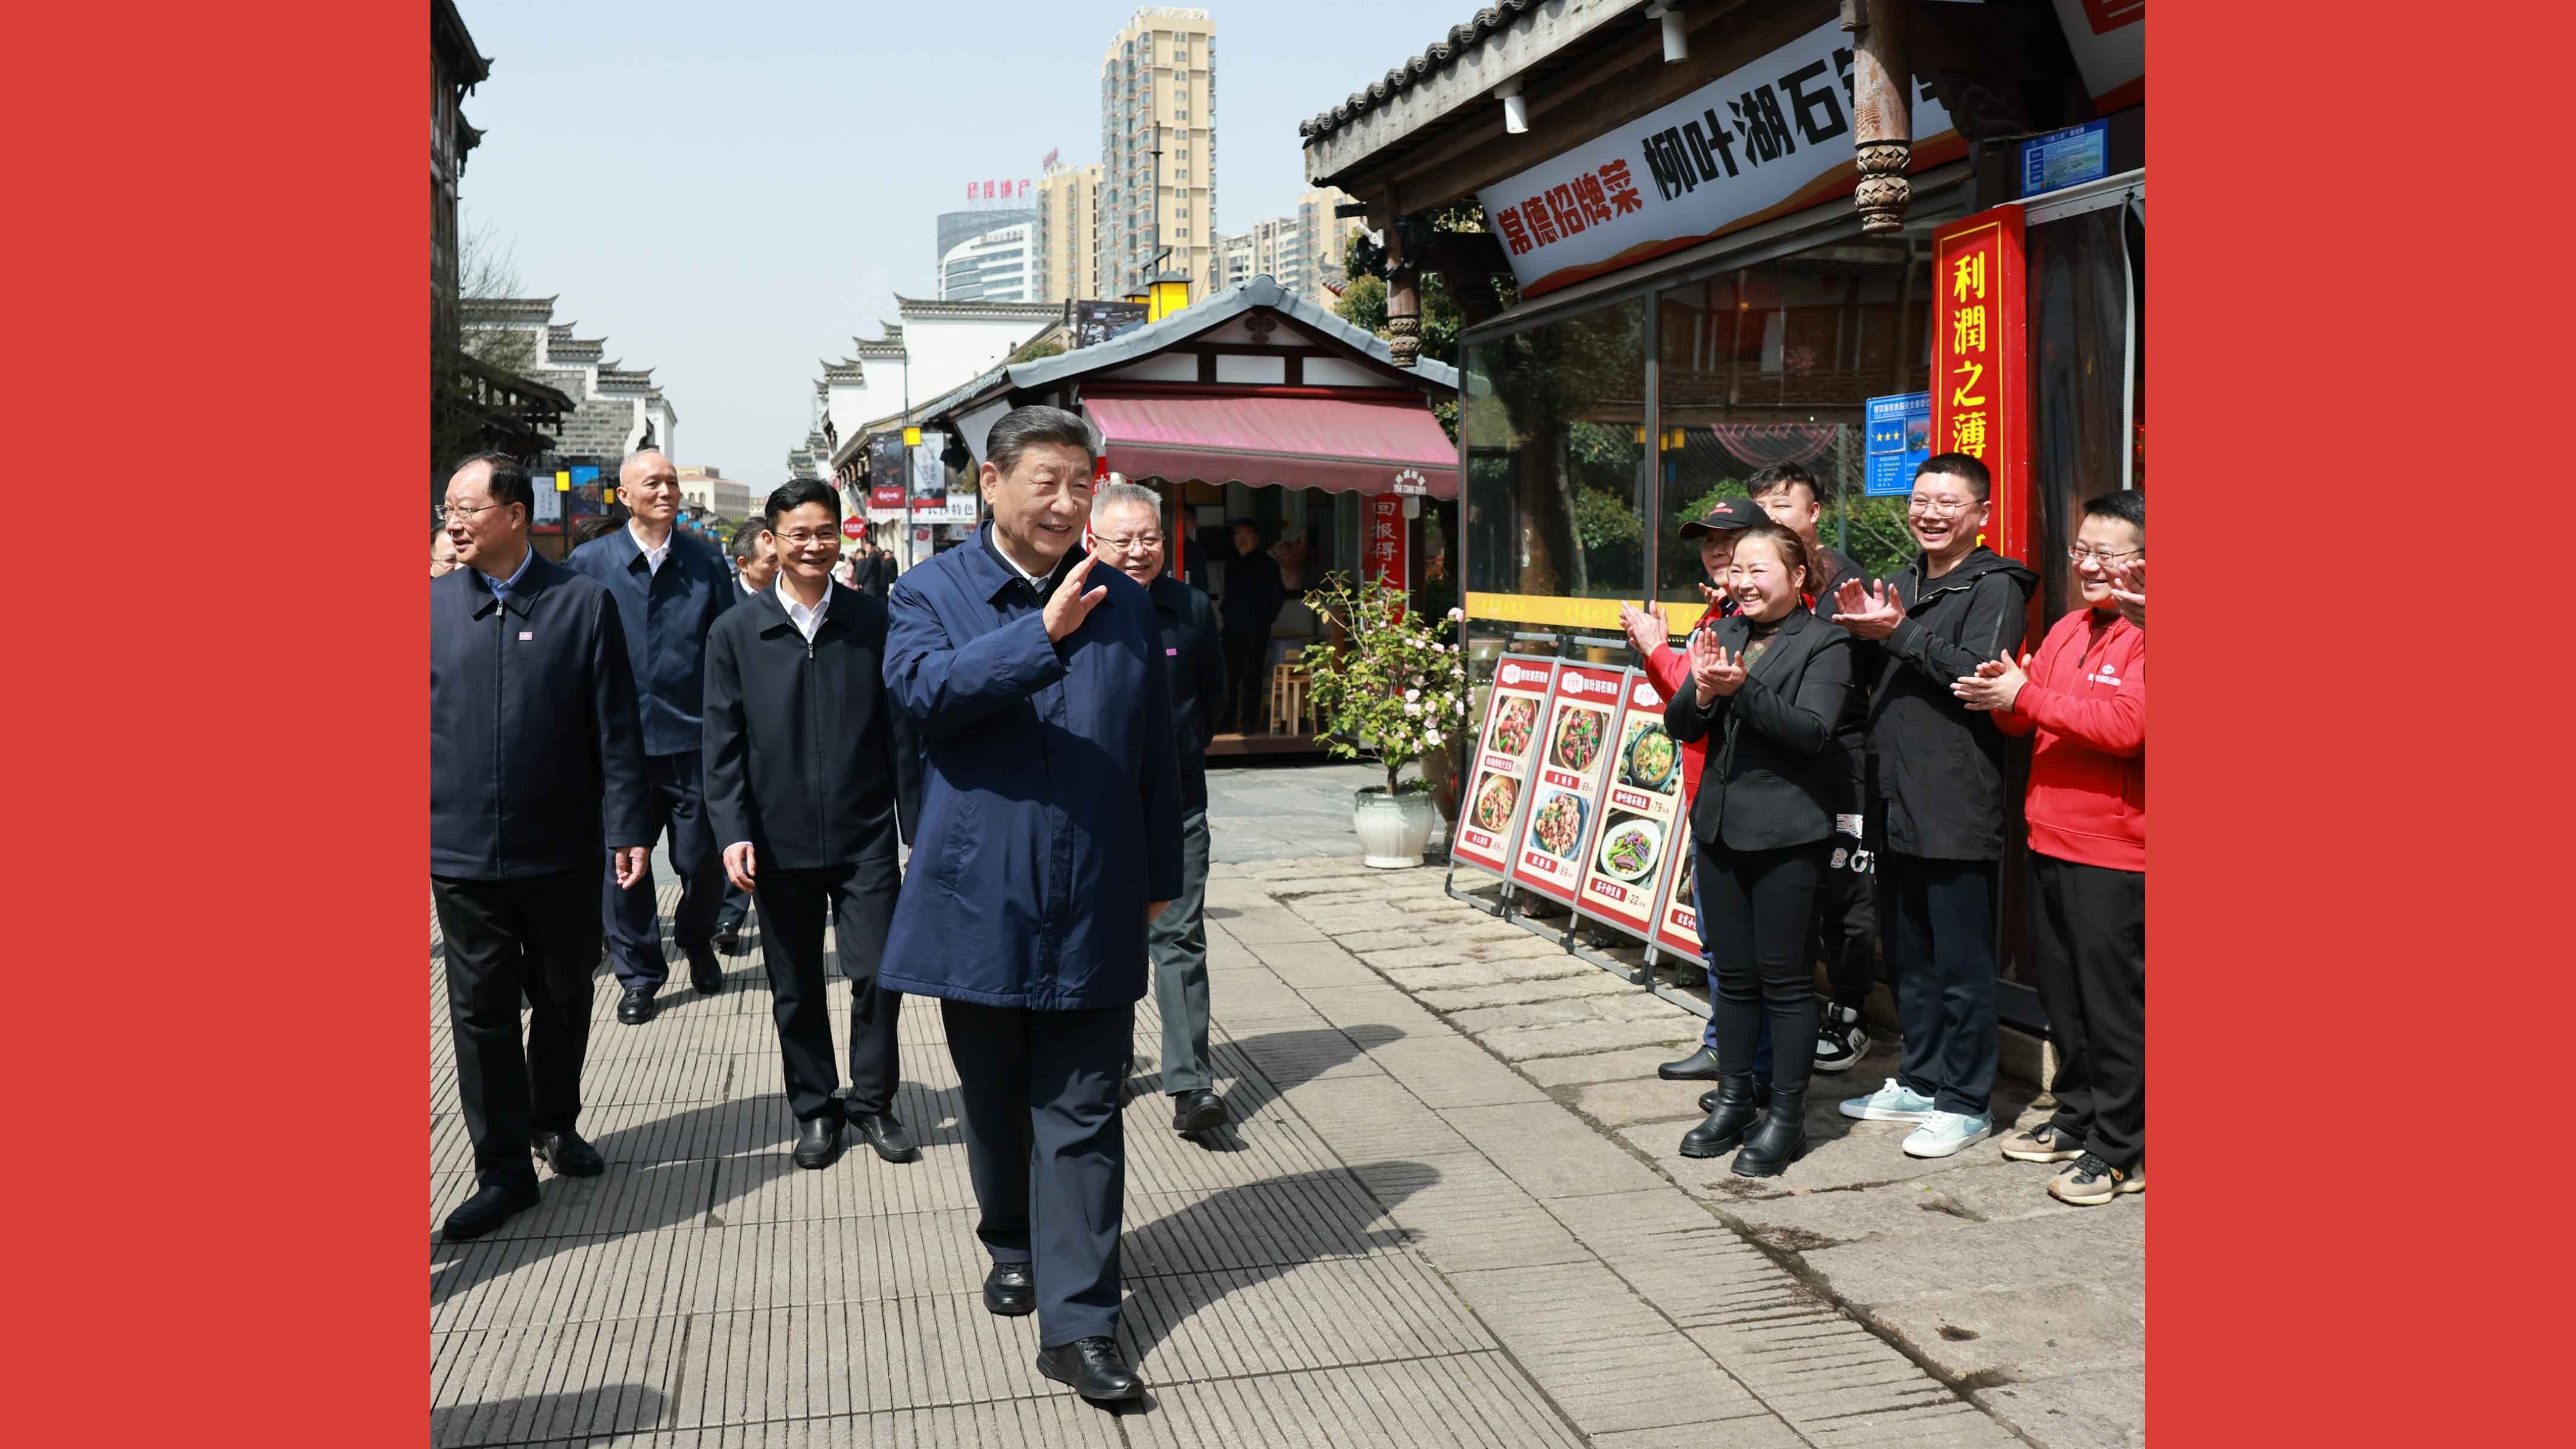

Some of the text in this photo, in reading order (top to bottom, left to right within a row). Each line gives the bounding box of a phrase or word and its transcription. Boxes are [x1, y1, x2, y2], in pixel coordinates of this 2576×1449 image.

[1641, 46, 1933, 202] 柳叶湖石
[1497, 158, 1643, 256] 常德招牌菜
